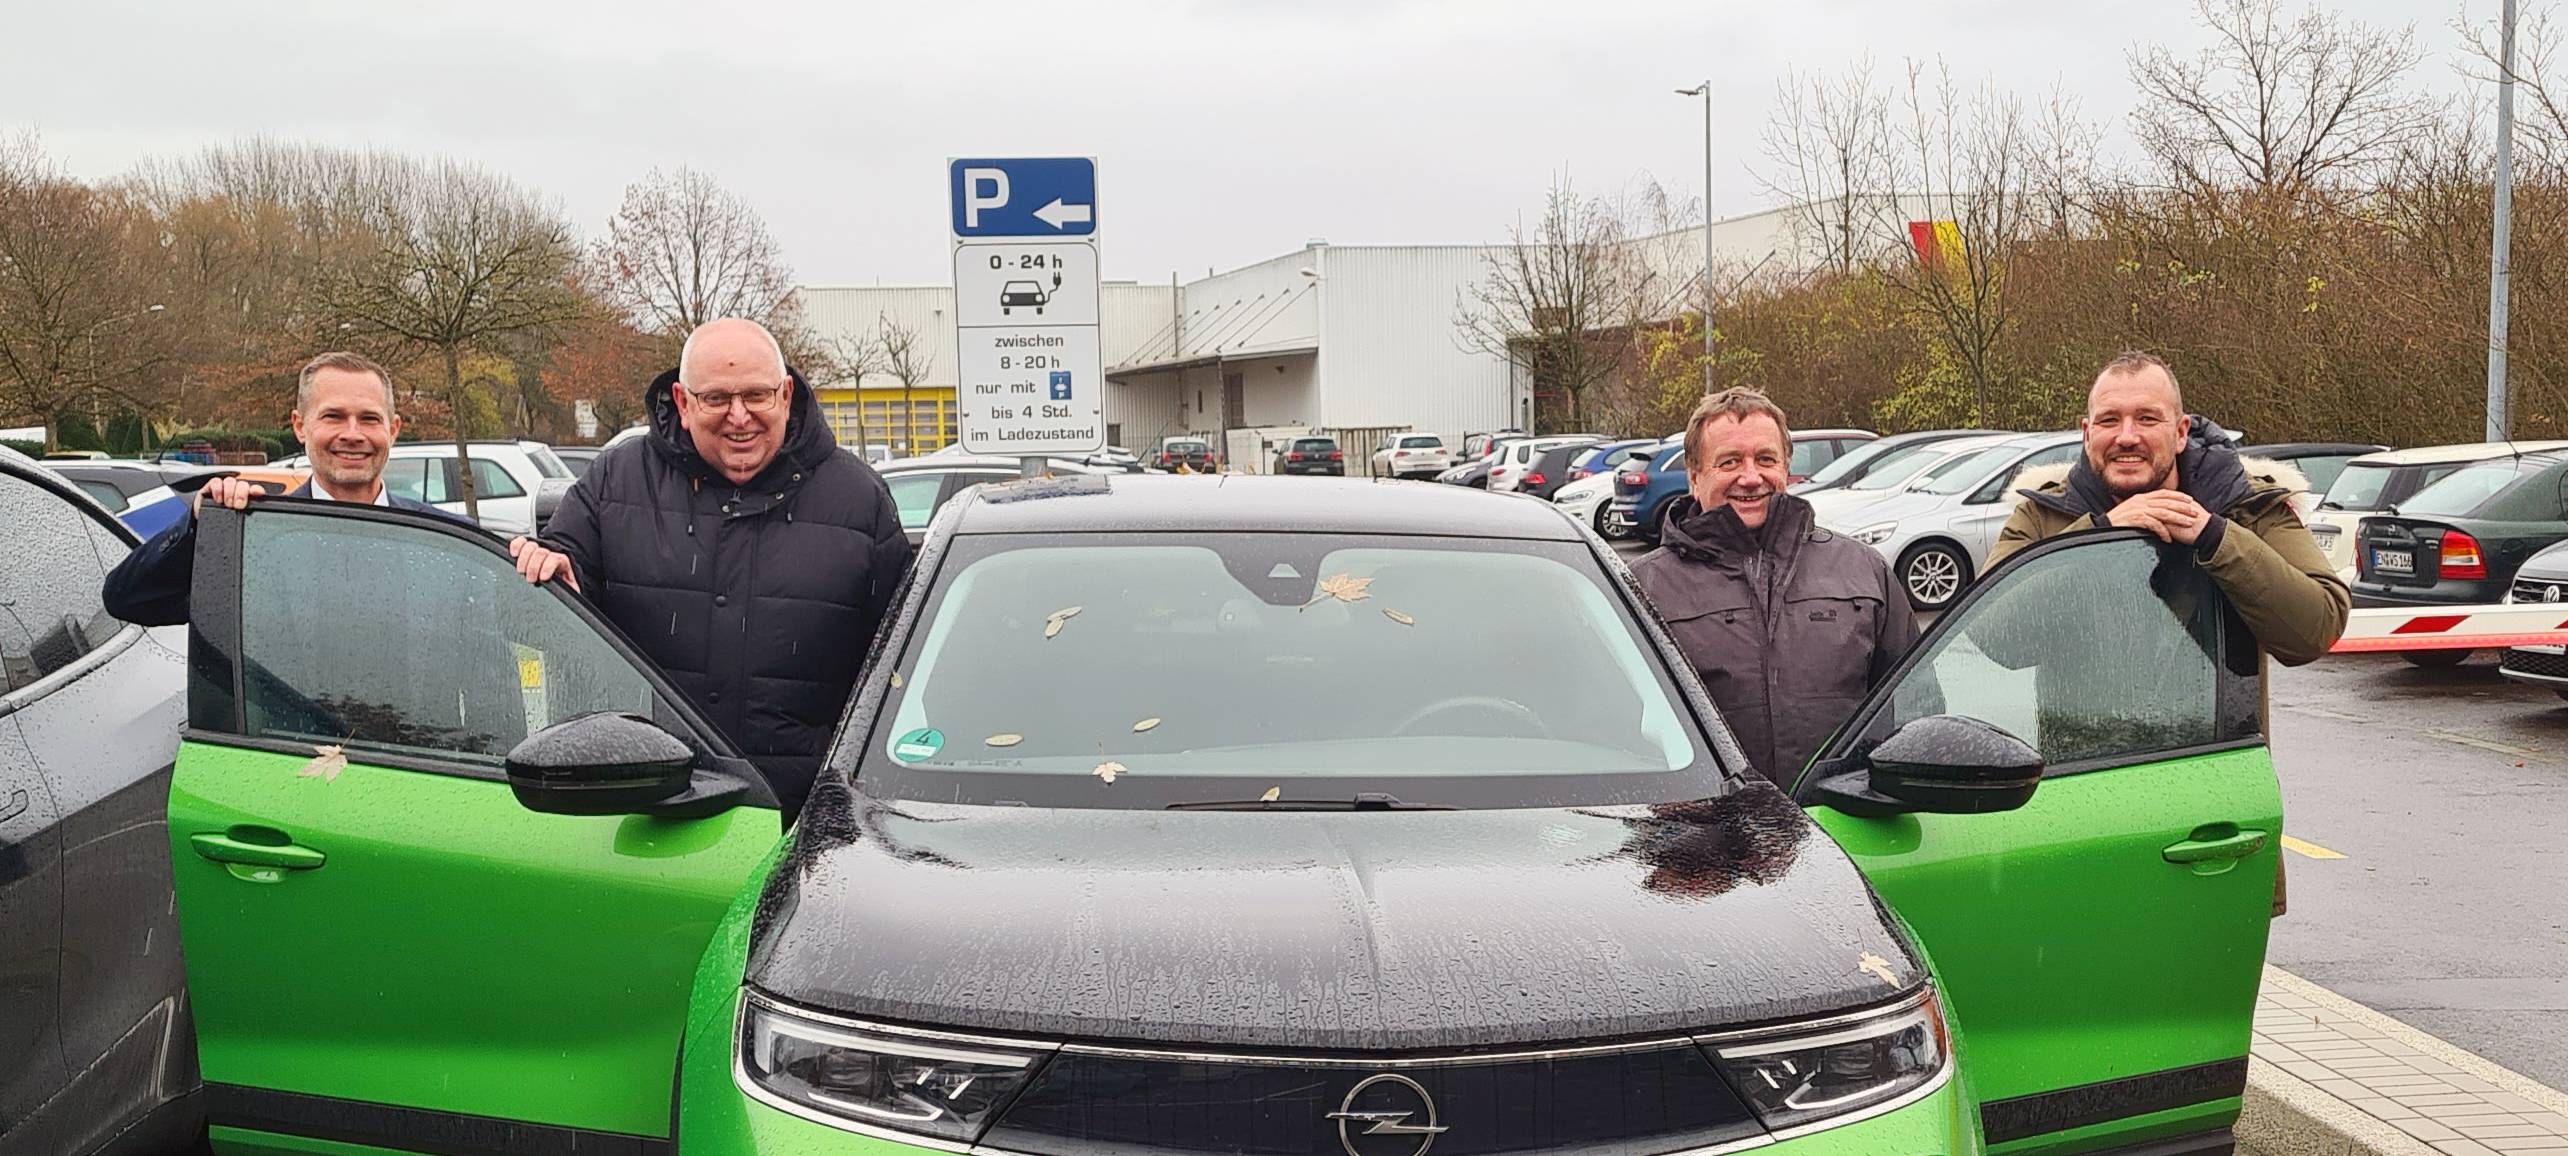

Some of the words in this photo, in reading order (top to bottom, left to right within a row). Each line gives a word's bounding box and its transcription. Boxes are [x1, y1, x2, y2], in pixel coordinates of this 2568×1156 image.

[964, 168, 1010, 228] P
[989, 255, 1002, 270] 0
[1020, 254, 1045, 269] 24
[1052, 254, 1063, 269] h
[994, 334, 1064, 348] zwischen
[1000, 356, 1011, 370] 8
[1024, 355, 1046, 370] 20
[1050, 355, 1060, 370] h
[975, 383, 1002, 395] nur
[1010, 381, 1036, 394] mit
[991, 406, 1013, 419] bis
[1022, 405, 1033, 418] 4
[1042, 404, 1073, 418] Std.
[970, 429, 989, 442] im
[998, 426, 1094, 441] Ladezustand
[914, 729, 930, 745] 4
